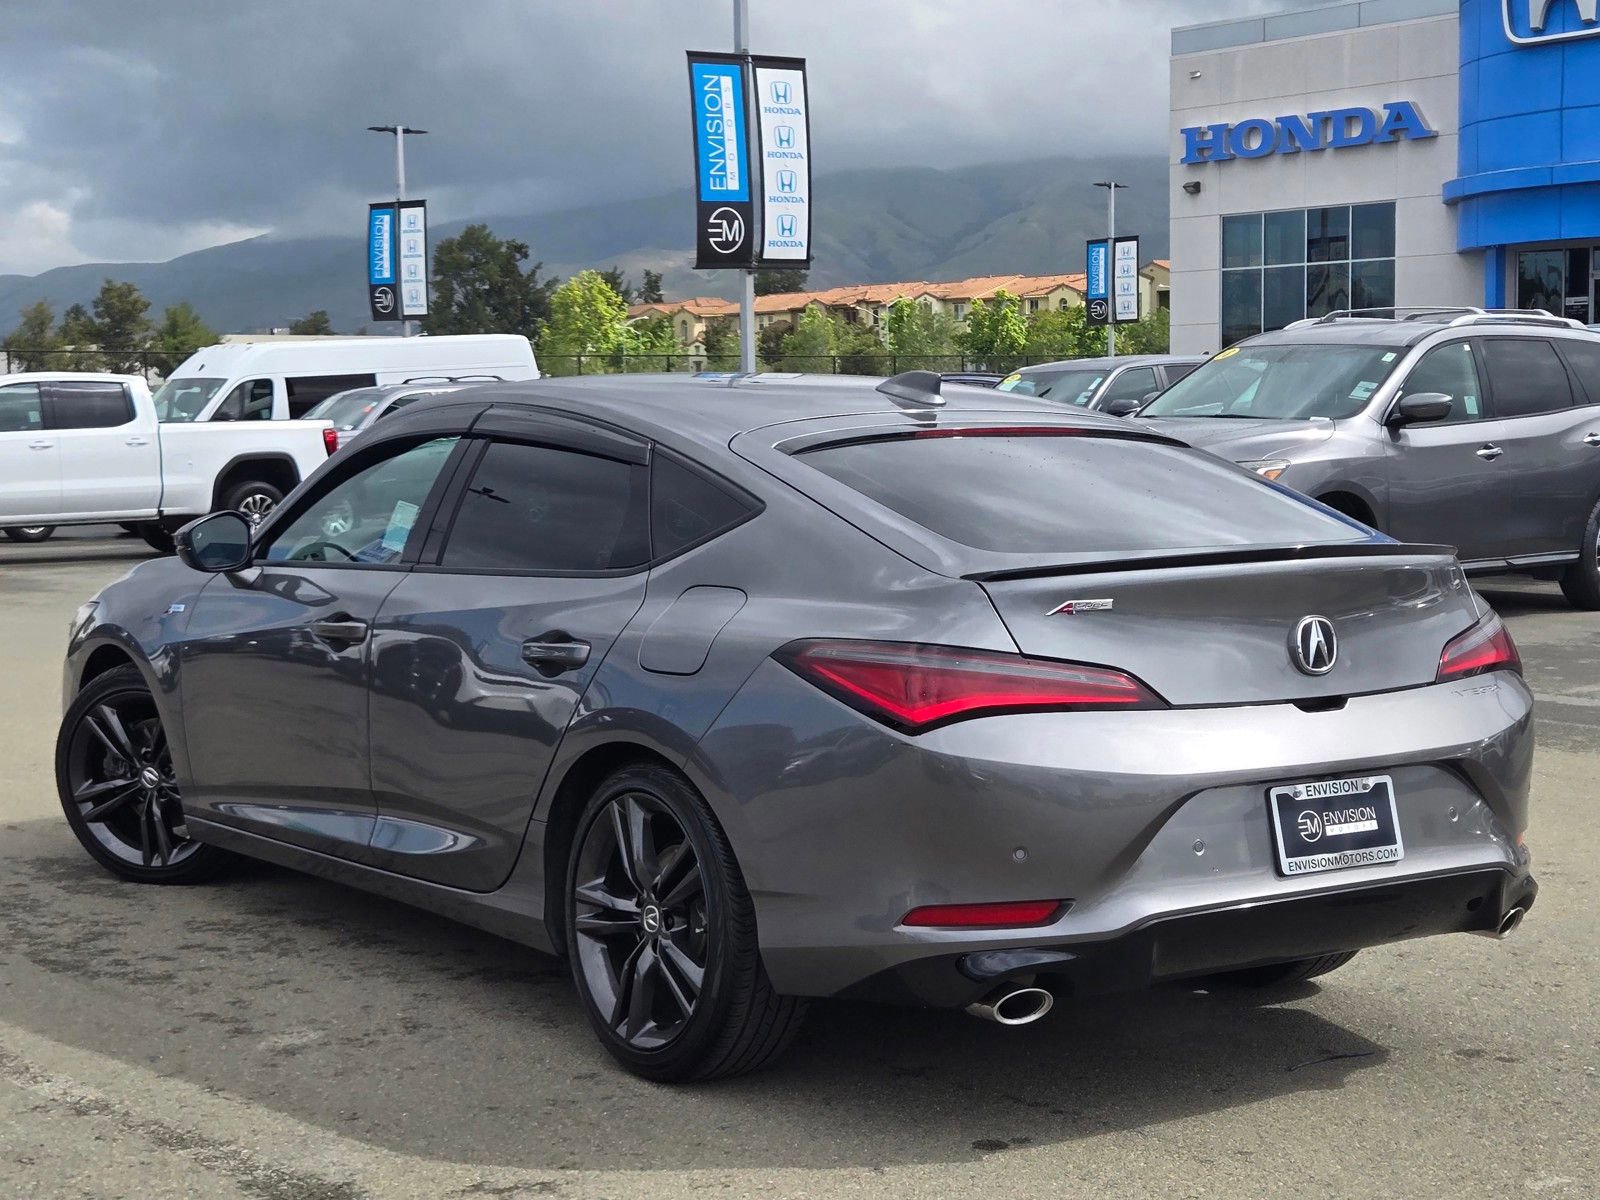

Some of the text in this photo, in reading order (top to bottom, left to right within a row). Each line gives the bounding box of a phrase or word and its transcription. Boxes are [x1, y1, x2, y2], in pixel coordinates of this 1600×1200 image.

[764, 106, 801, 116] HONDA
[702, 75, 727, 190] ENVISION
[1180, 100, 1438, 165] HONDA
[767, 151, 804, 160] HONDA
[768, 195, 805, 204] HONDA
[374, 215, 384, 279] ENVISION
[768, 239, 804, 248] HONDA
[1092, 247, 1100, 295] ENVISION
[1305, 780, 1359, 797] ENVISION
[1322, 806, 1377, 825] ENVISION
[1288, 848, 1399, 872] ENVISIONMOTORS.COM
